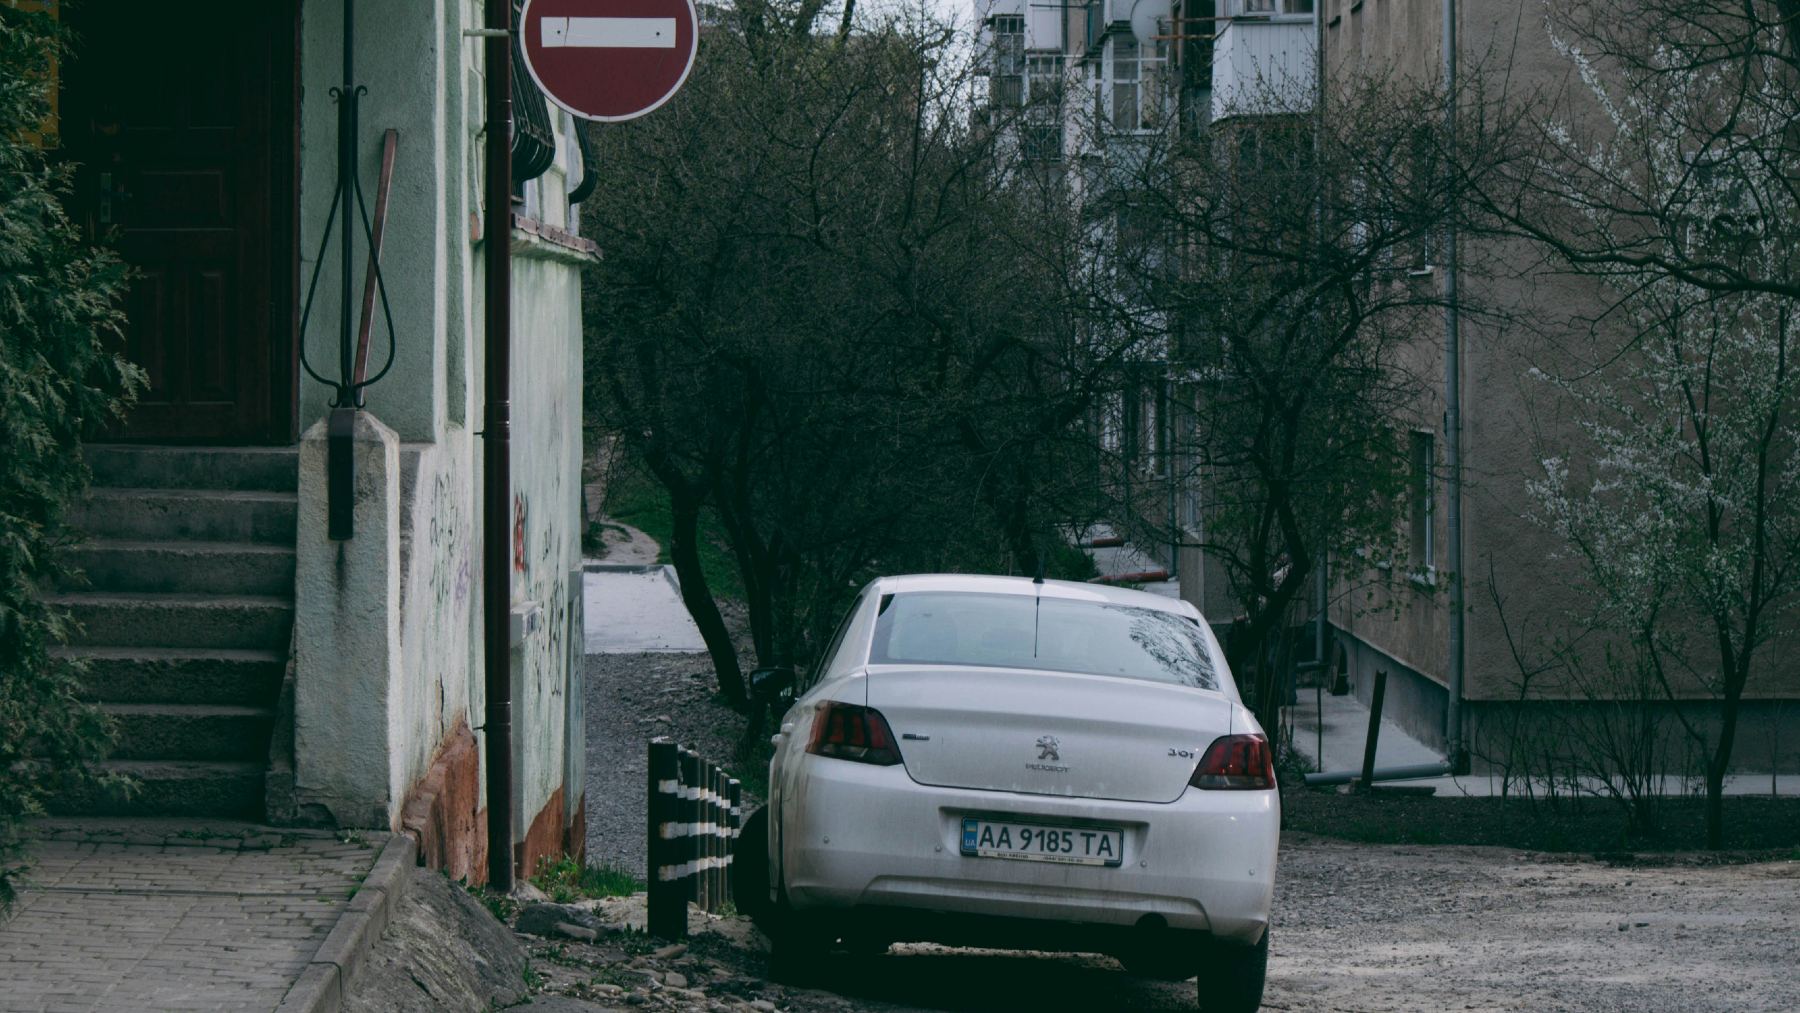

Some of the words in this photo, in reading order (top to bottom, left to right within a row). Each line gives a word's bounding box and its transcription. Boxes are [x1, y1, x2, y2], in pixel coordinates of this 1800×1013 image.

[1025, 762, 1070, 772] PEUGEOT
[978, 825, 1012, 849] AA
[1020, 828, 1073, 853] 9185
[1080, 832, 1113, 857] TA
